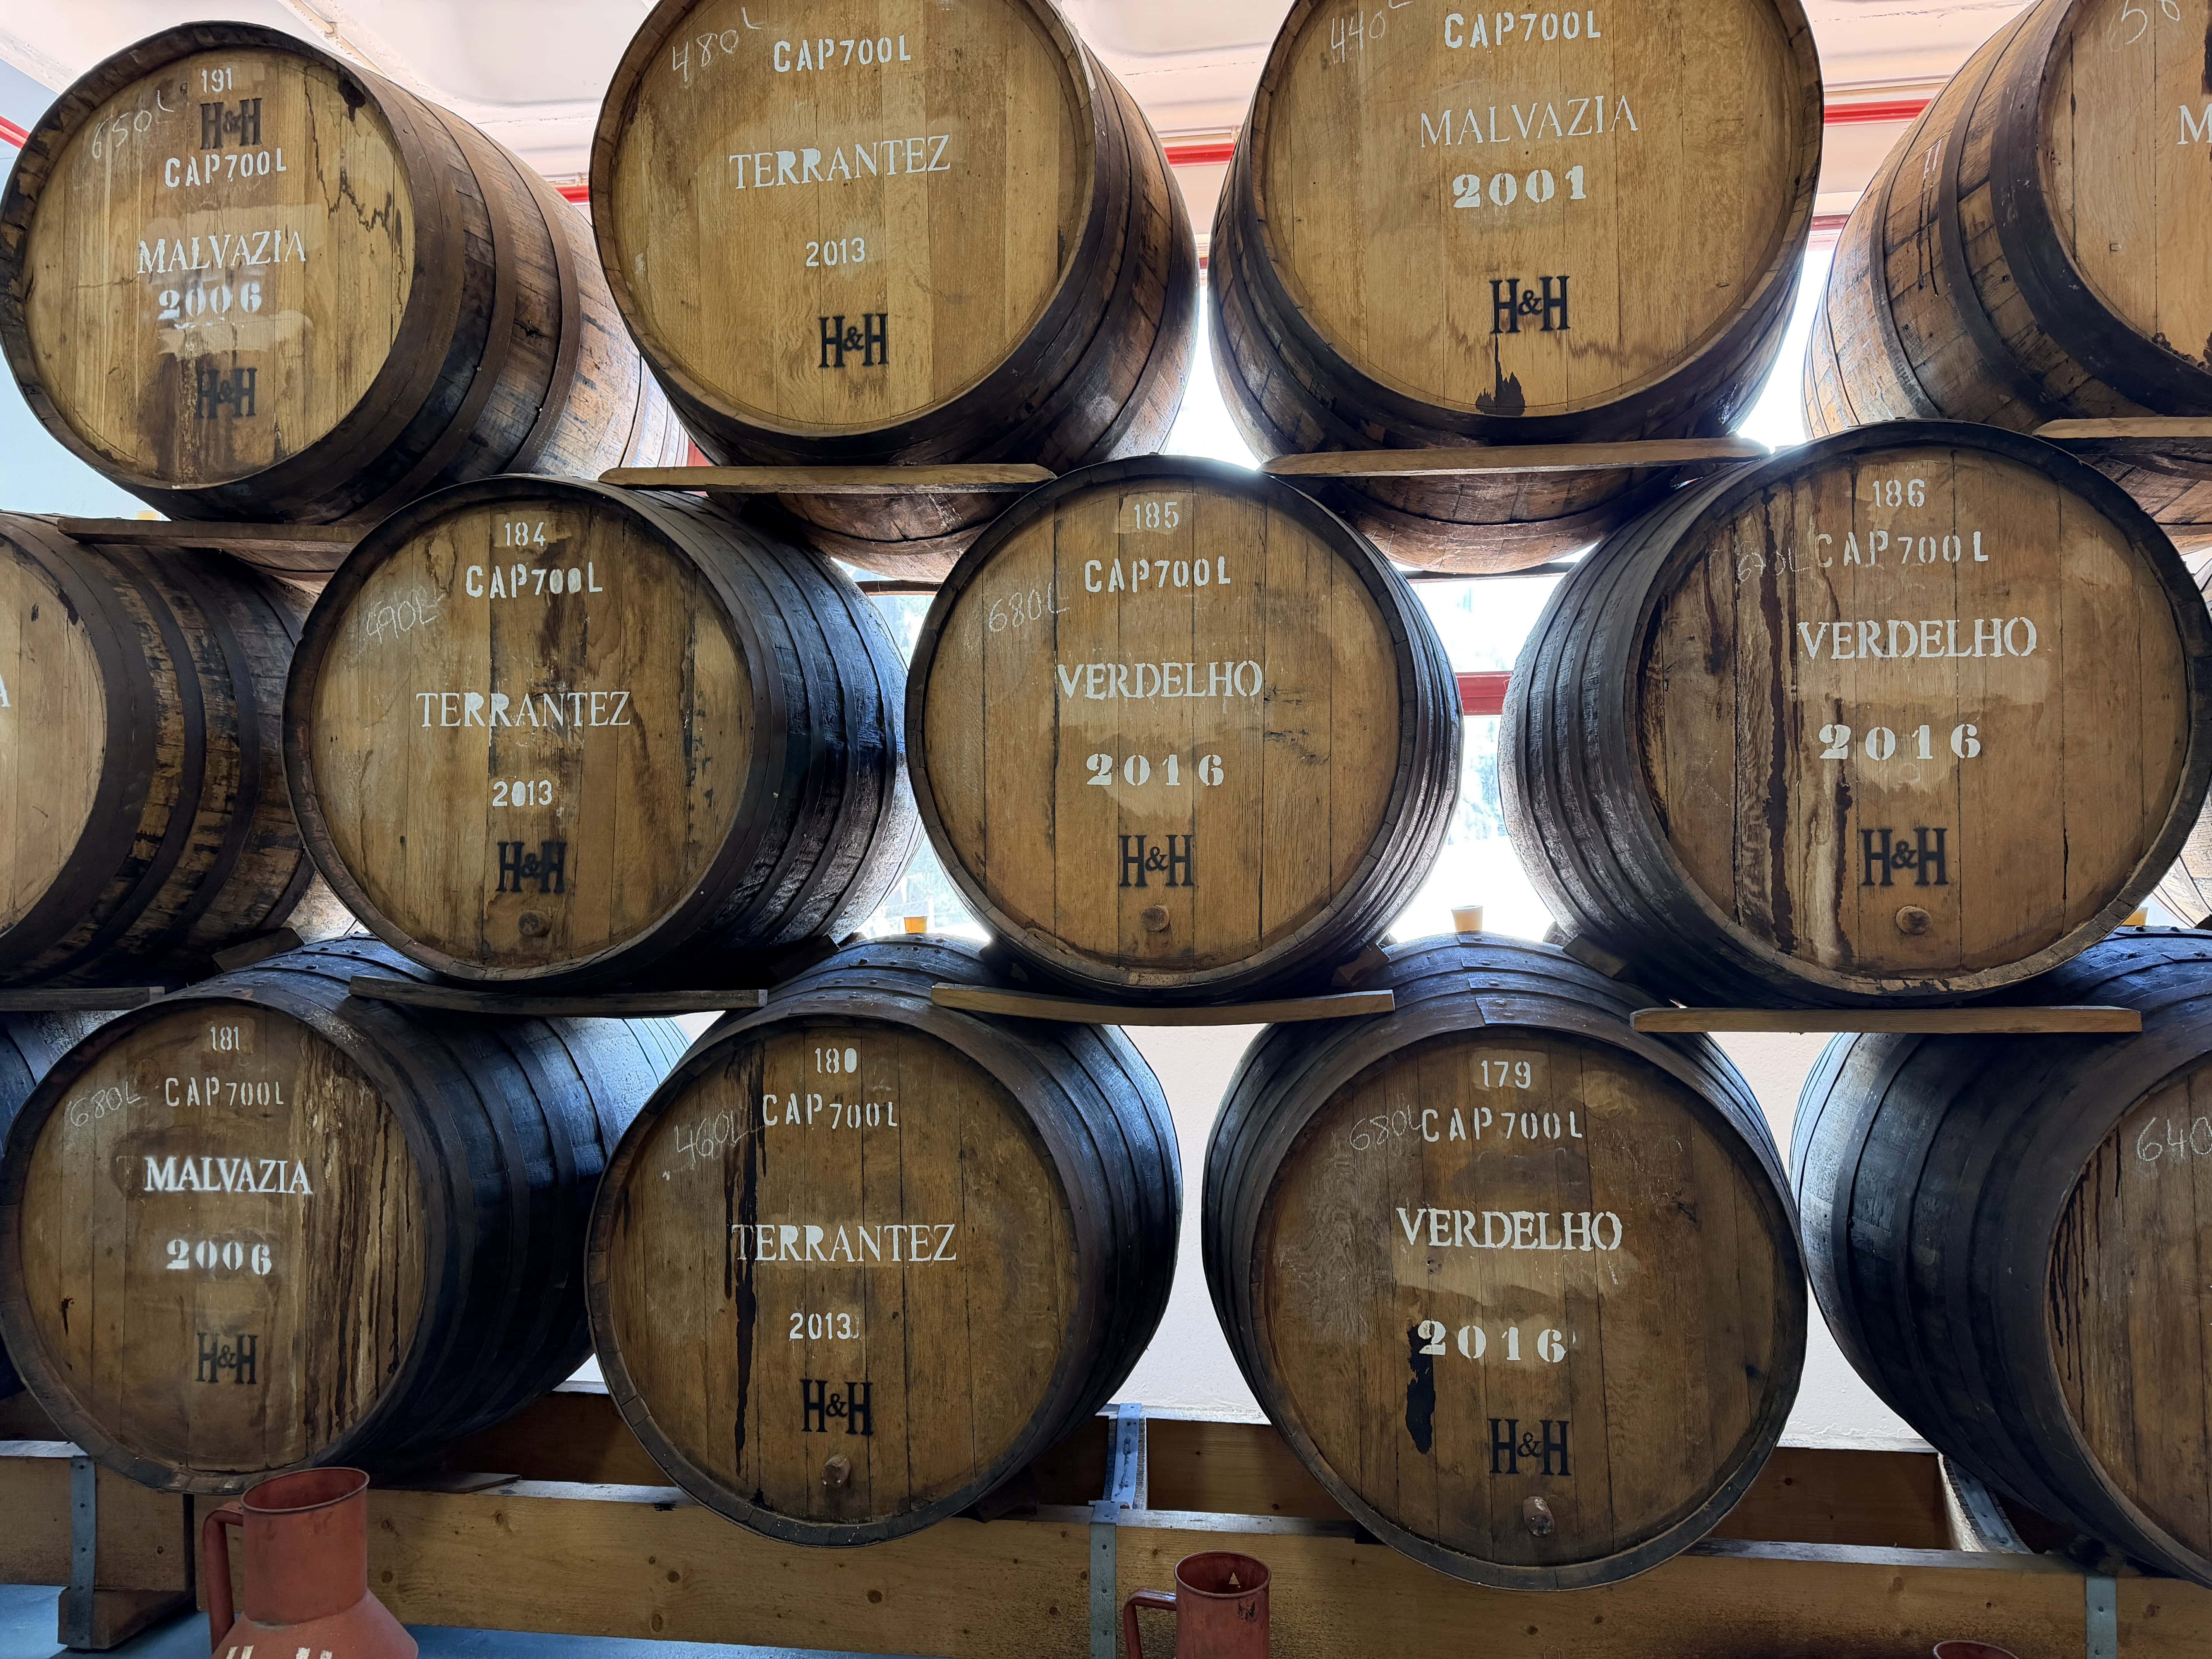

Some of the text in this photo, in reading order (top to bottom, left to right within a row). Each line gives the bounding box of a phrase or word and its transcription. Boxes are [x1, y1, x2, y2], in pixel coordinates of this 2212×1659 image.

[673, 7, 763, 82] 480L
[202, 68, 232, 93] 191
[92, 90, 174, 158] 650L
[201, 98, 262, 150] H&H
[1420, 95, 1638, 148] MALVAZIA
[729, 134, 951, 190] TERRANTEZ
[1453, 165, 1587, 208] 2001
[136, 229, 306, 275] MALVAZIA
[805, 237, 866, 267] 2013
[157, 281, 262, 319] 2006
[1489, 275, 1570, 334] H&H
[818, 313, 889, 369] H&H
[196, 367, 258, 420] H&H
[1134, 501, 1180, 529] 185
[1873, 479, 1925, 508] 186
[504, 522, 546, 547] 184
[989, 582, 1070, 632] 680L
[1797, 617, 2037, 660] VERDELHO
[1057, 660, 1263, 699] VERDELHO
[416, 691, 630, 727] TERRANTEZ
[1819, 724, 1981, 760] 2016
[1086, 753, 1224, 787] 2016
[492, 780, 552, 807] 2013
[496, 841, 567, 894] H&H
[1119, 835, 1194, 887] H&H
[1861, 828, 1948, 886] H&H
[210, 1025, 239, 1051] 181
[815, 1047, 857, 1073] 180
[1481, 1061, 1531, 1089] 179
[70, 1082, 141, 1126] 680L
[144, 1156, 313, 1195] MALVAZIA
[732, 1224, 957, 1262] TERRANTEZ
[1396, 1207, 1623, 1251] VERDELHO
[167, 1238, 273, 1276] 2006
[789, 1313, 851, 1340] 2013
[1418, 1319, 1567, 1363] 2016
[196, 1332, 258, 1385] H&H
[800, 1379, 873, 1435] H&H
[1489, 1418, 1571, 1476] H&H
